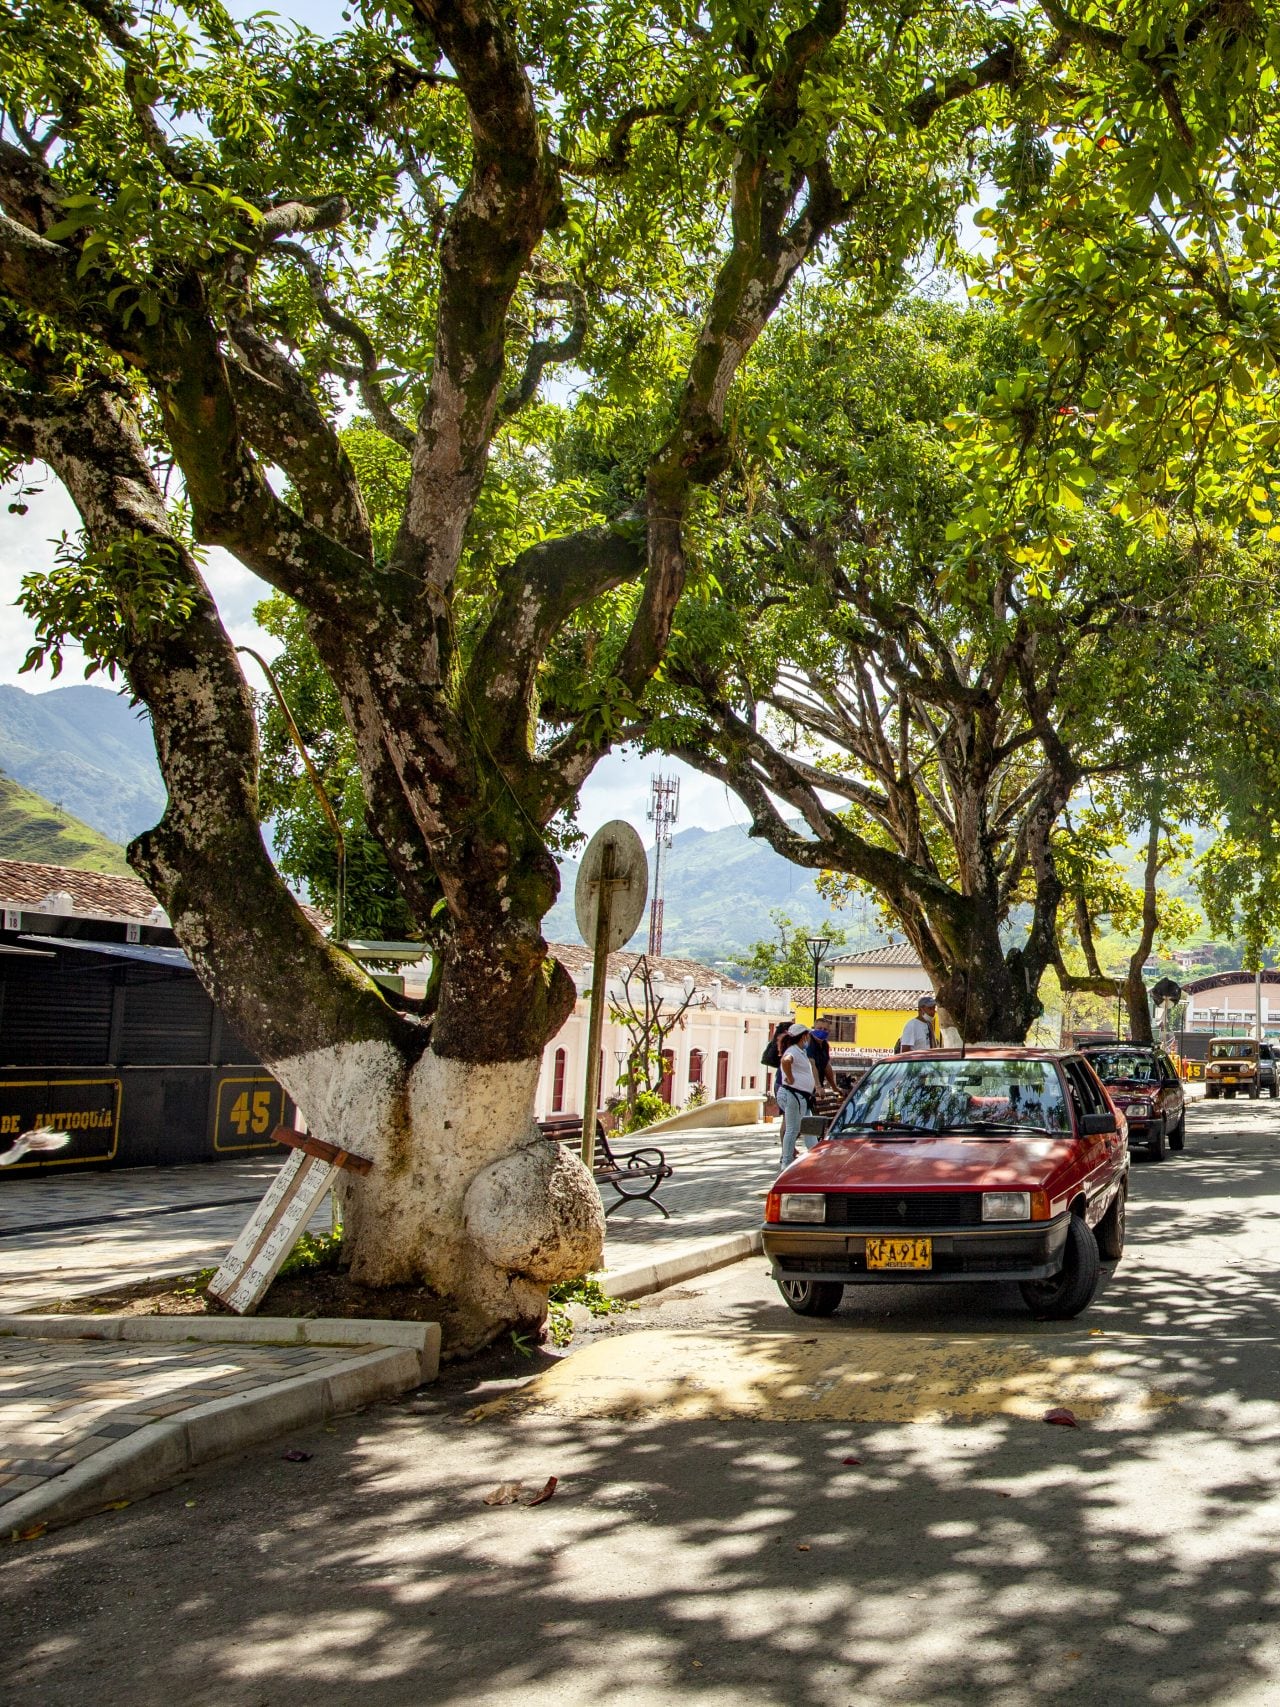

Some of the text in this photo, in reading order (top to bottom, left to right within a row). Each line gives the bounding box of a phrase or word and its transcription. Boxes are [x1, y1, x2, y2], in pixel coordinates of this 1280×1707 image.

[9, 918, 18, 928] 18
[0, 1110, 112, 1133] DE ANTIOQUIA
[230, 1091, 271, 1134] 45
